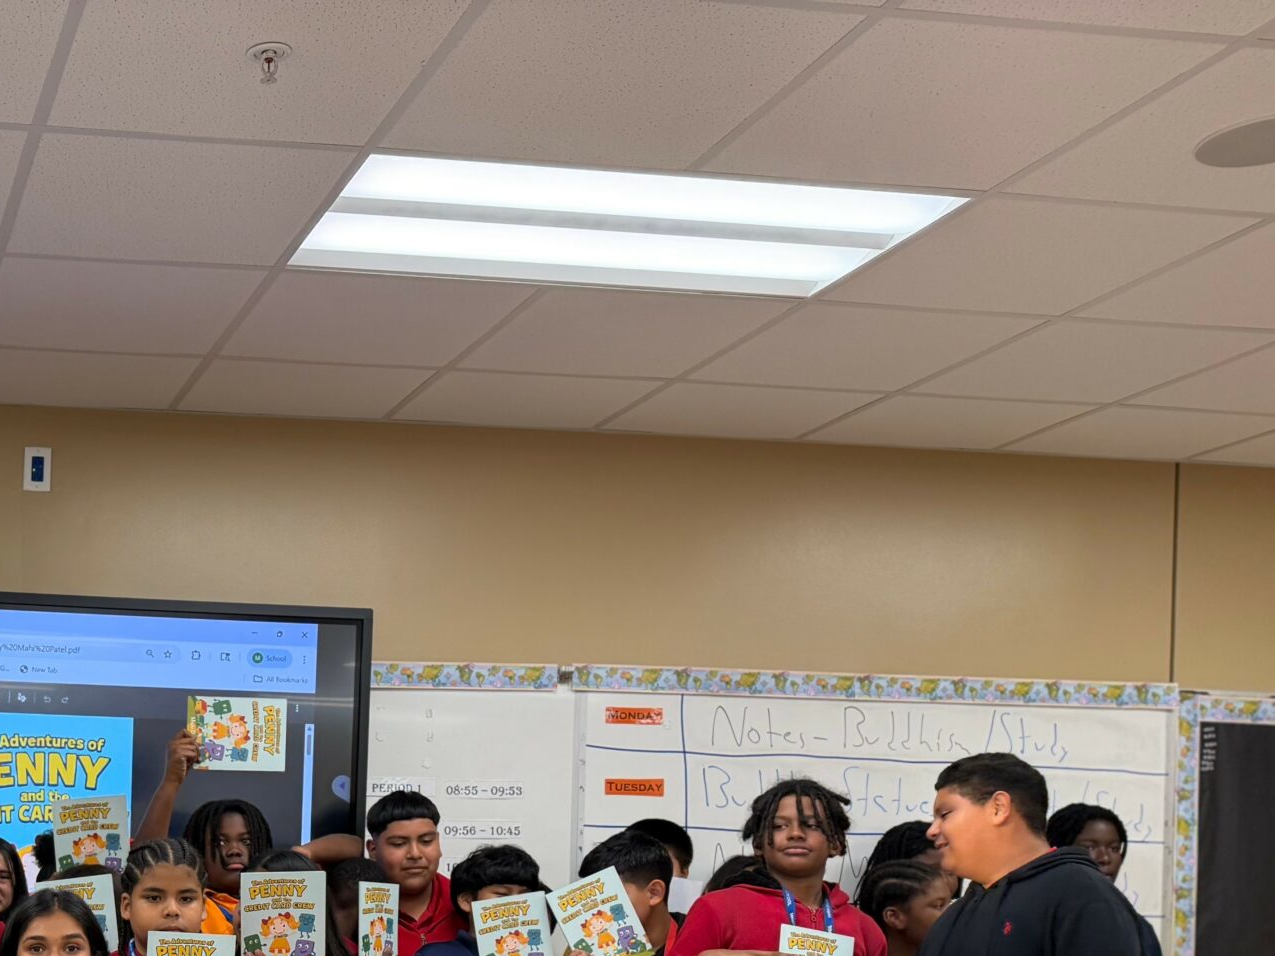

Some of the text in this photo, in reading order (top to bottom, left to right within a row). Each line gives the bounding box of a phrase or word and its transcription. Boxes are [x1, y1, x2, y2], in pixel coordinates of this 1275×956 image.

[266, 655, 287, 663] School
[31, 666, 46, 674] New
[266, 675, 308, 684] All Bookmarks
[605, 709, 663, 723] MONDAY
[263, 704, 275, 756] PENNY
[87, 738, 105, 752] of
[372, 783, 421, 794] PERIOD 1
[445, 784, 523, 797] 08:55 09:53
[606, 780, 664, 794] TUESDAY
[20, 789, 70, 803] and the
[18, 805, 53, 825] CAR
[59, 807, 112, 824] PENNY
[444, 824, 521, 837] 09:56 10:45
[248, 884, 308, 900] PENNY
[558, 882, 607, 913] PENNY
[243, 901, 315, 912] CREDIT CARD CREW
[480, 904, 531, 924] PENNY
[788, 937, 838, 956] PENNY
